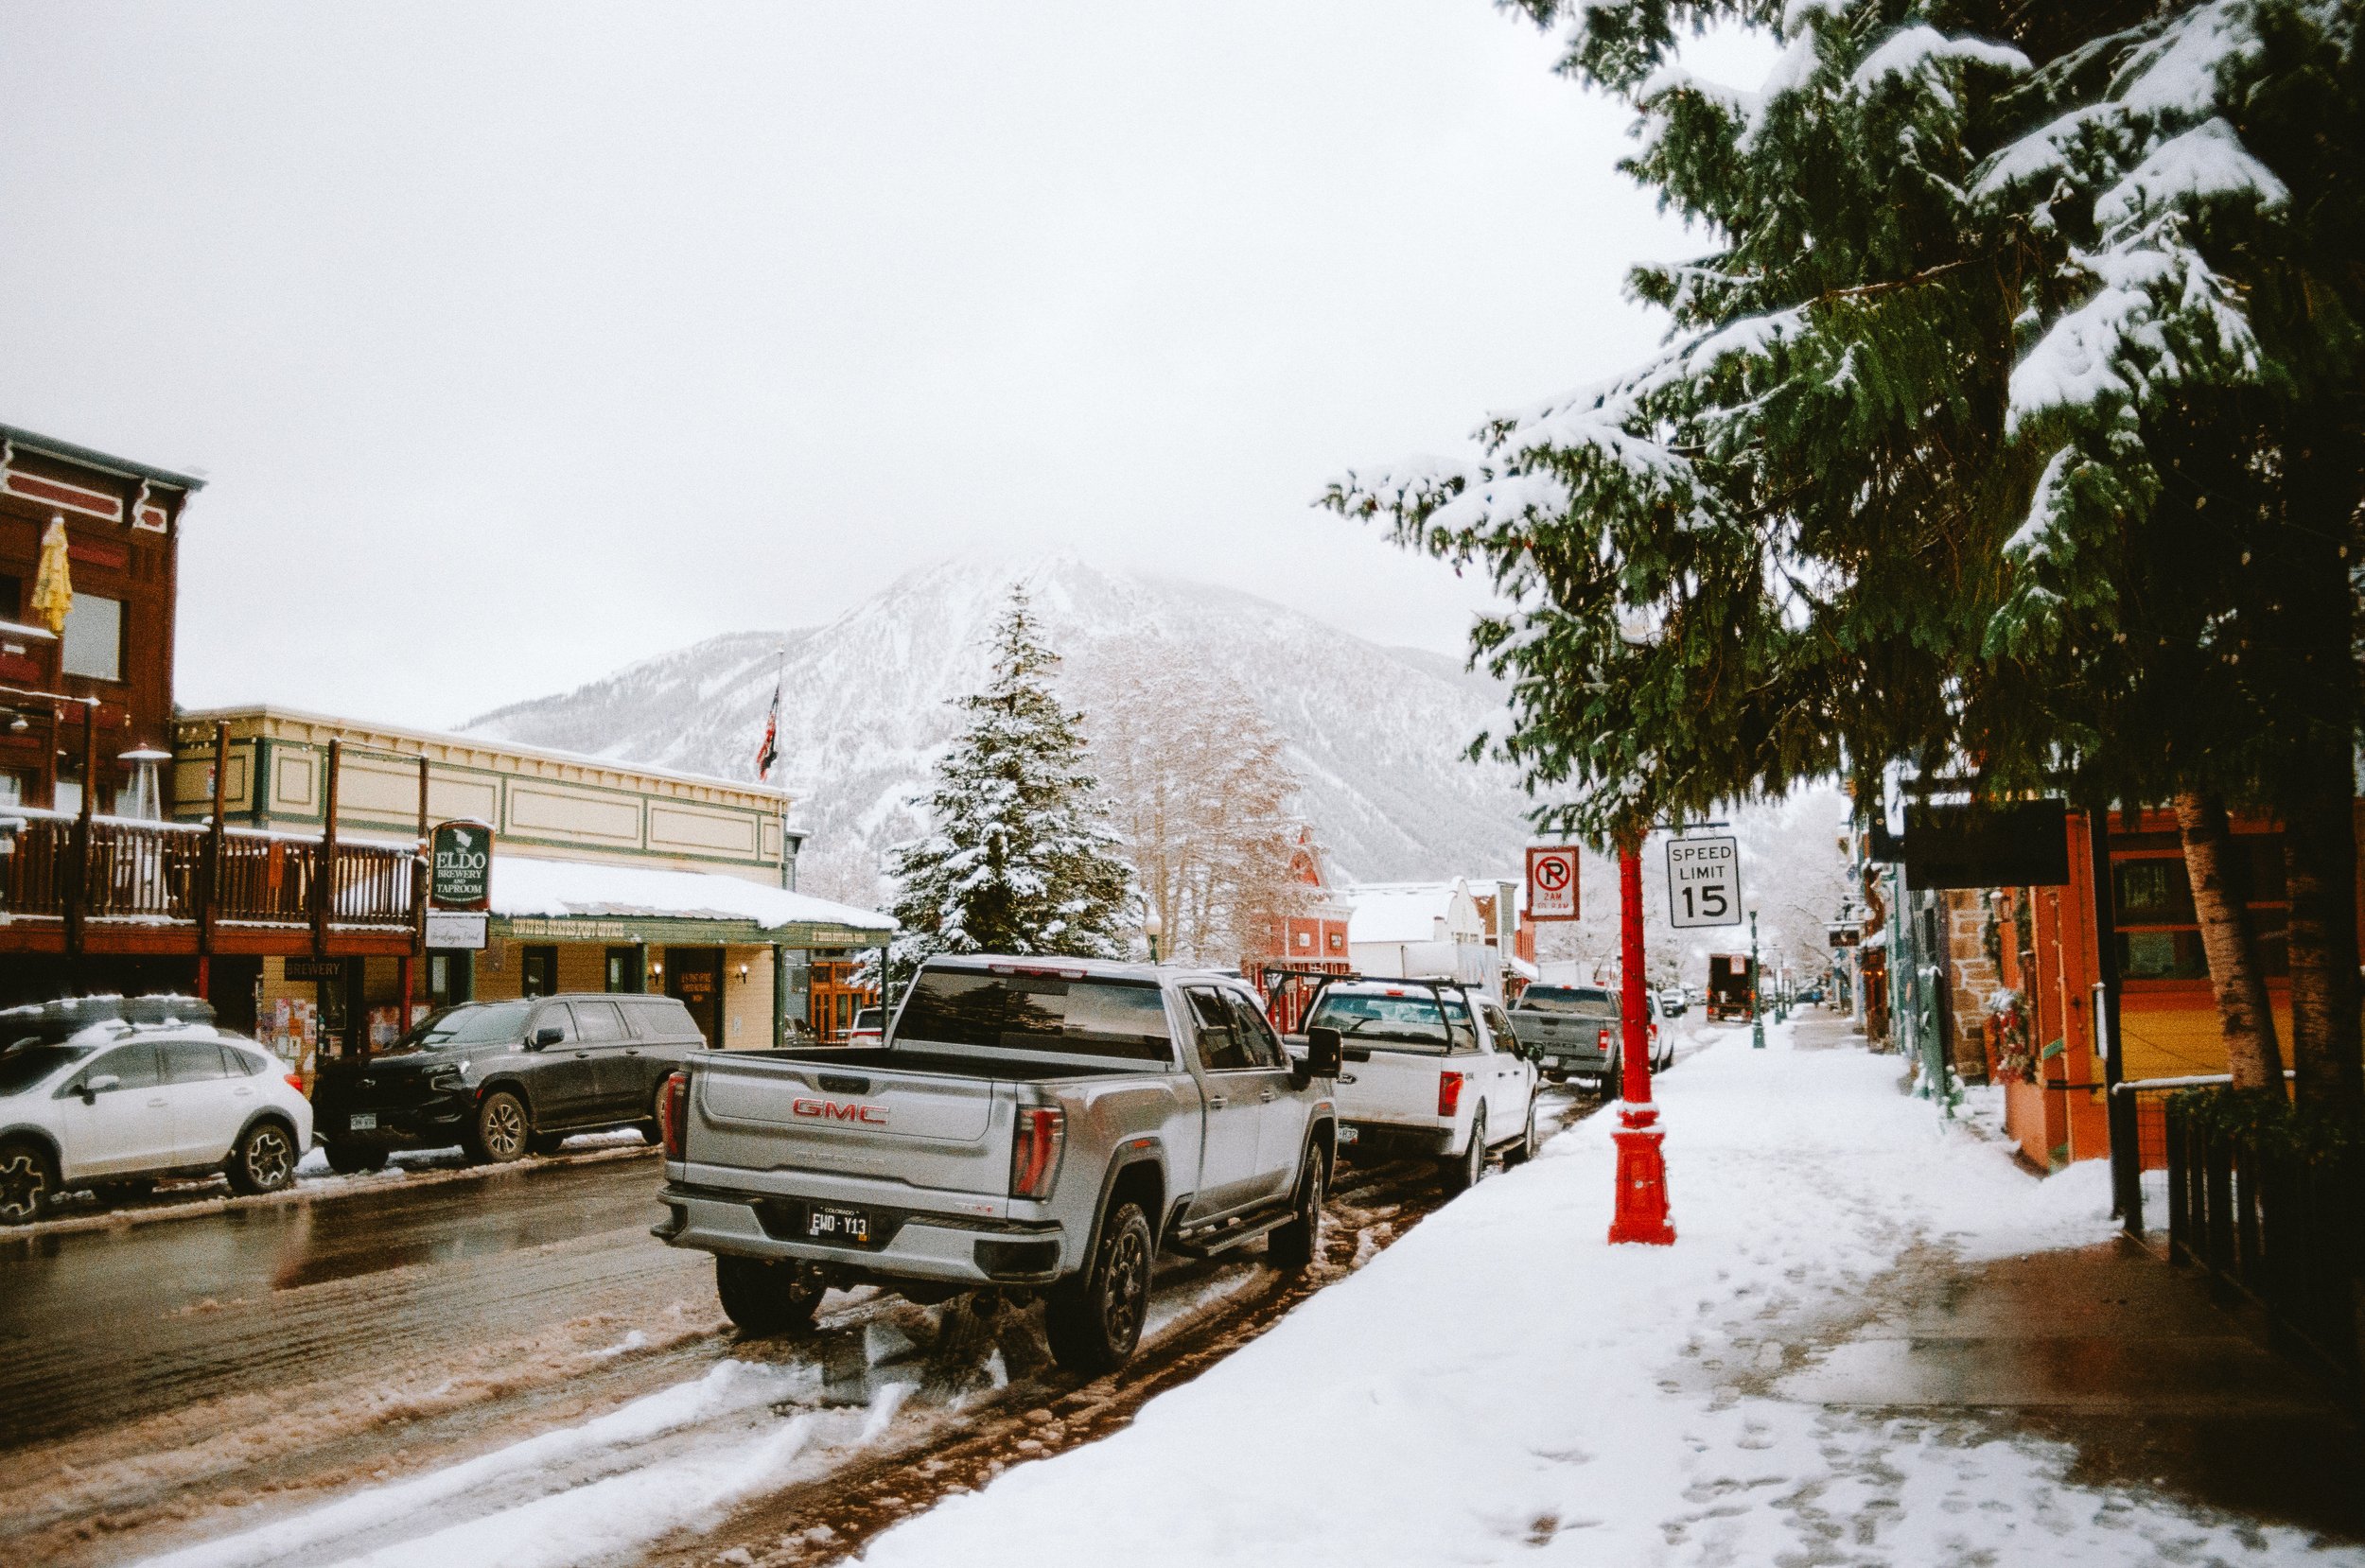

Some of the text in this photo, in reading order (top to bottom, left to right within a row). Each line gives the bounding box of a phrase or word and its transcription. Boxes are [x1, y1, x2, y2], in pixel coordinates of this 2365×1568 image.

[436, 852, 486, 869] ELDO
[1673, 845, 1731, 862] SPEED
[437, 869, 482, 879] BREWERY
[1679, 866, 1726, 880] LIMIT
[436, 884, 482, 893] TAPROOM
[1682, 885, 1727, 918] 15
[548, 919, 576, 935] STATES
[577, 920, 596, 936] POST
[286, 962, 341, 976] BREWERY
[792, 1097, 889, 1124] GMC
[825, 1207, 855, 1216] COLORADO
